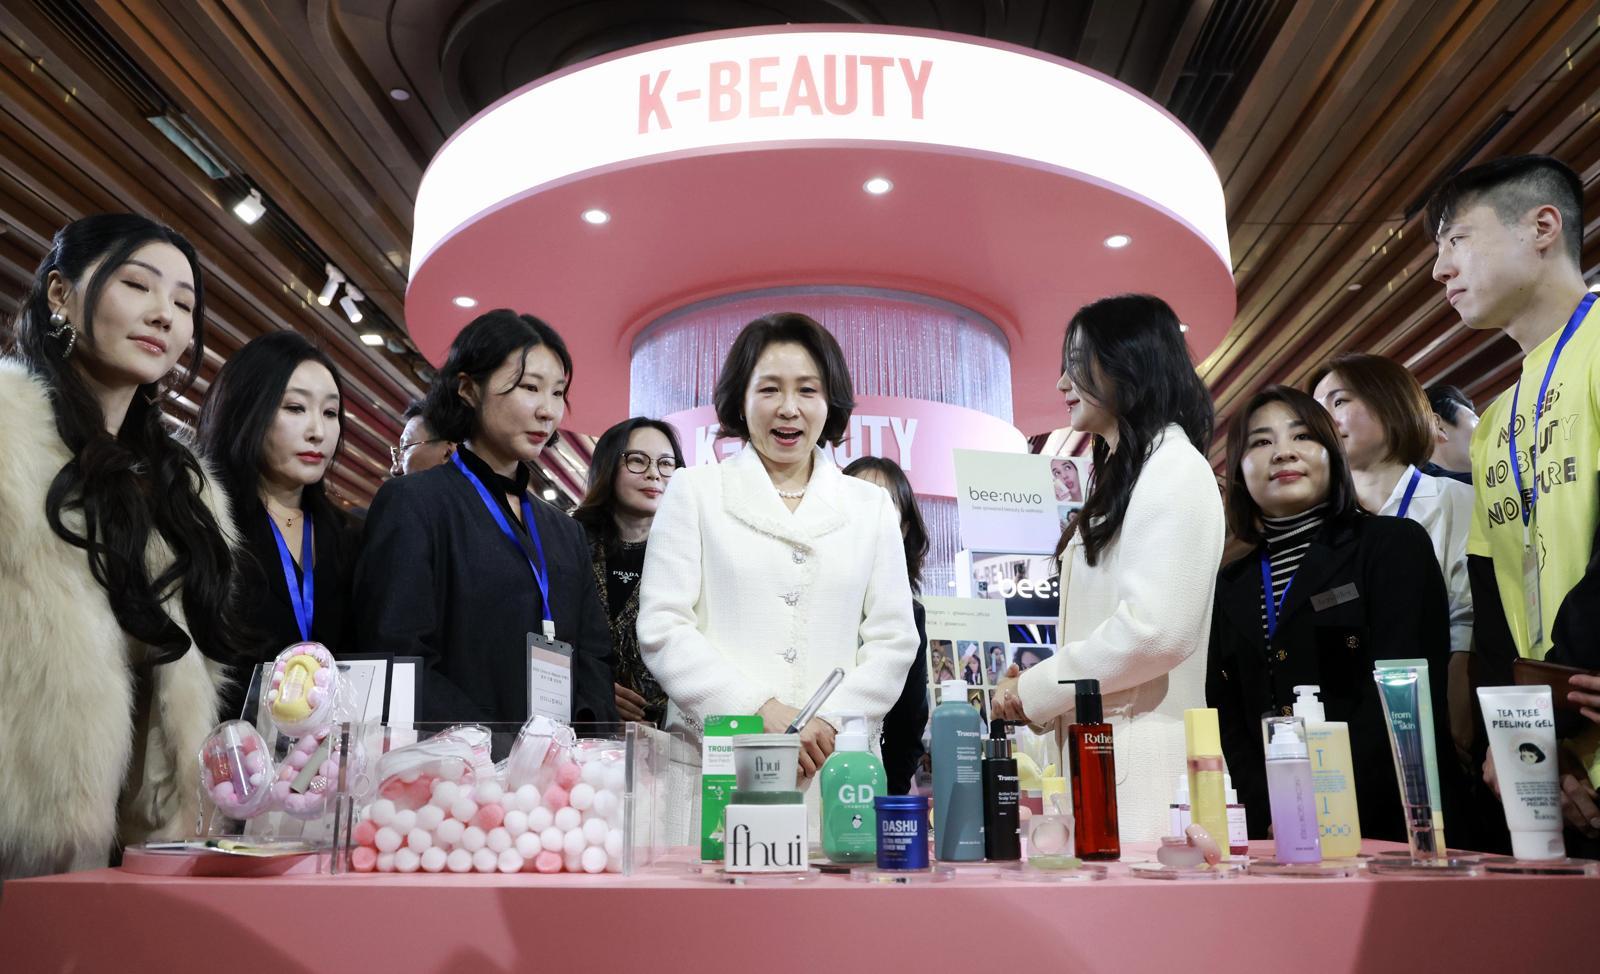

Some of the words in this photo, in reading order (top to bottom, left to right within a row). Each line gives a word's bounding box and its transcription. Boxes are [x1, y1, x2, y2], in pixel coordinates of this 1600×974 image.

[638, 54, 934, 134] K-BEAUTY
[696, 415, 918, 470] K-UTY
[968, 486, 1042, 504] bee:nuvo
[1488, 497, 1520, 529] NO
[613, 570, 639, 578] PRADA
[1391, 711, 1411, 719] from
[1497, 708, 1513, 718] TEA
[1515, 708, 1541, 718] TREE
[1492, 720, 1531, 729] PEELING
[1535, 720, 1553, 728] GEL
[838, 784, 875, 804] GD
[882, 820, 918, 832] DASHU
[728, 823, 803, 866] fhui
